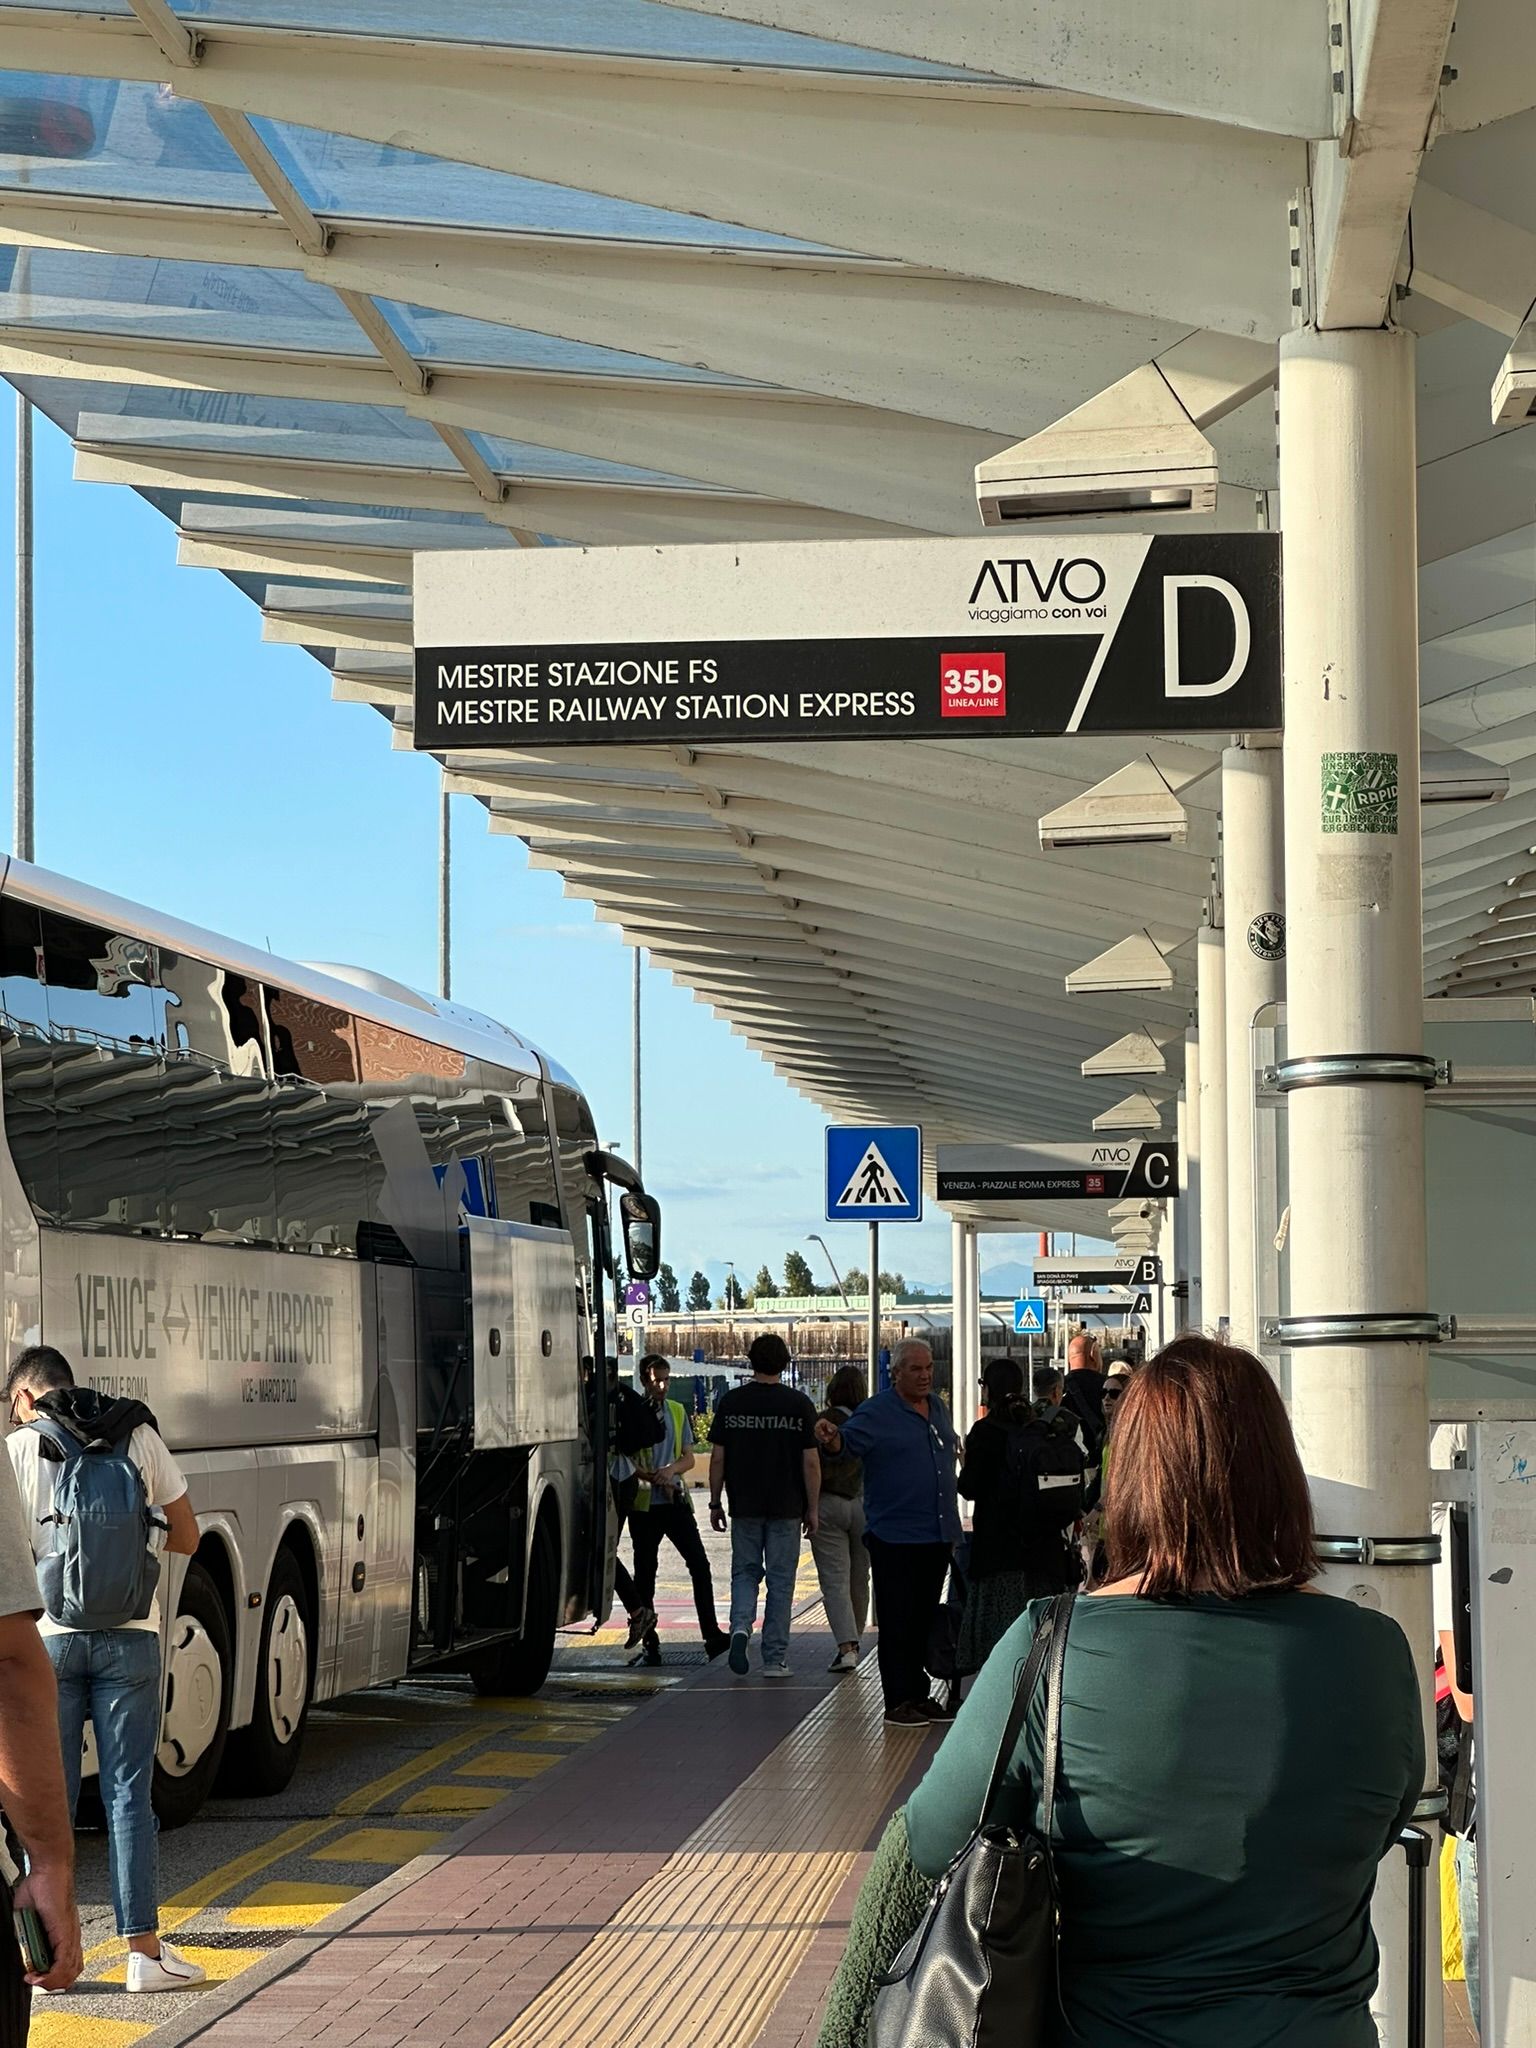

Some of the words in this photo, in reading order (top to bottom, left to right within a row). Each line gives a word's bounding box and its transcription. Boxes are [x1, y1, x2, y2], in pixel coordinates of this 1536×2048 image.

[968, 558, 1106, 604] ATVO
[968, 607, 1048, 623] viaggiamo
[1052, 607, 1081, 618] con
[1085, 605, 1107, 618] voi
[1163, 574, 1250, 697] D
[438, 663, 539, 689] MESTRE
[548, 660, 679, 687] STAZIONE
[689, 659, 718, 684] FS
[944, 669, 1002, 695] 35b
[437, 699, 539, 725] MESTRE
[549, 696, 667, 722] RAILWAY
[675, 693, 789, 720] STATION
[800, 691, 916, 717] EXPRESS
[948, 698, 999, 708] LINEA/LINE
[1357, 785, 1398, 805] RAPID
[1091, 1148, 1131, 1162] ATVO
[1144, 1152, 1169, 1189] C
[943, 1182, 976, 1190] VENEZIA
[982, 1181, 1018, 1190] PIAZZALE
[1019, 1181, 1045, 1189] ROMA
[1047, 1180, 1080, 1189] EXPRESS
[1088, 1178, 1101, 1187] 35
[1114, 1259, 1135, 1267] ATVO
[1143, 1261, 1156, 1281] B
[627, 1286, 634, 1296] P
[1139, 1296, 1150, 1311] A
[75, 1273, 157, 1360] VENICE
[194, 1283, 261, 1362] VENICE
[265, 1290, 334, 1365] AIRPORT
[631, 1307, 643, 1325] G
